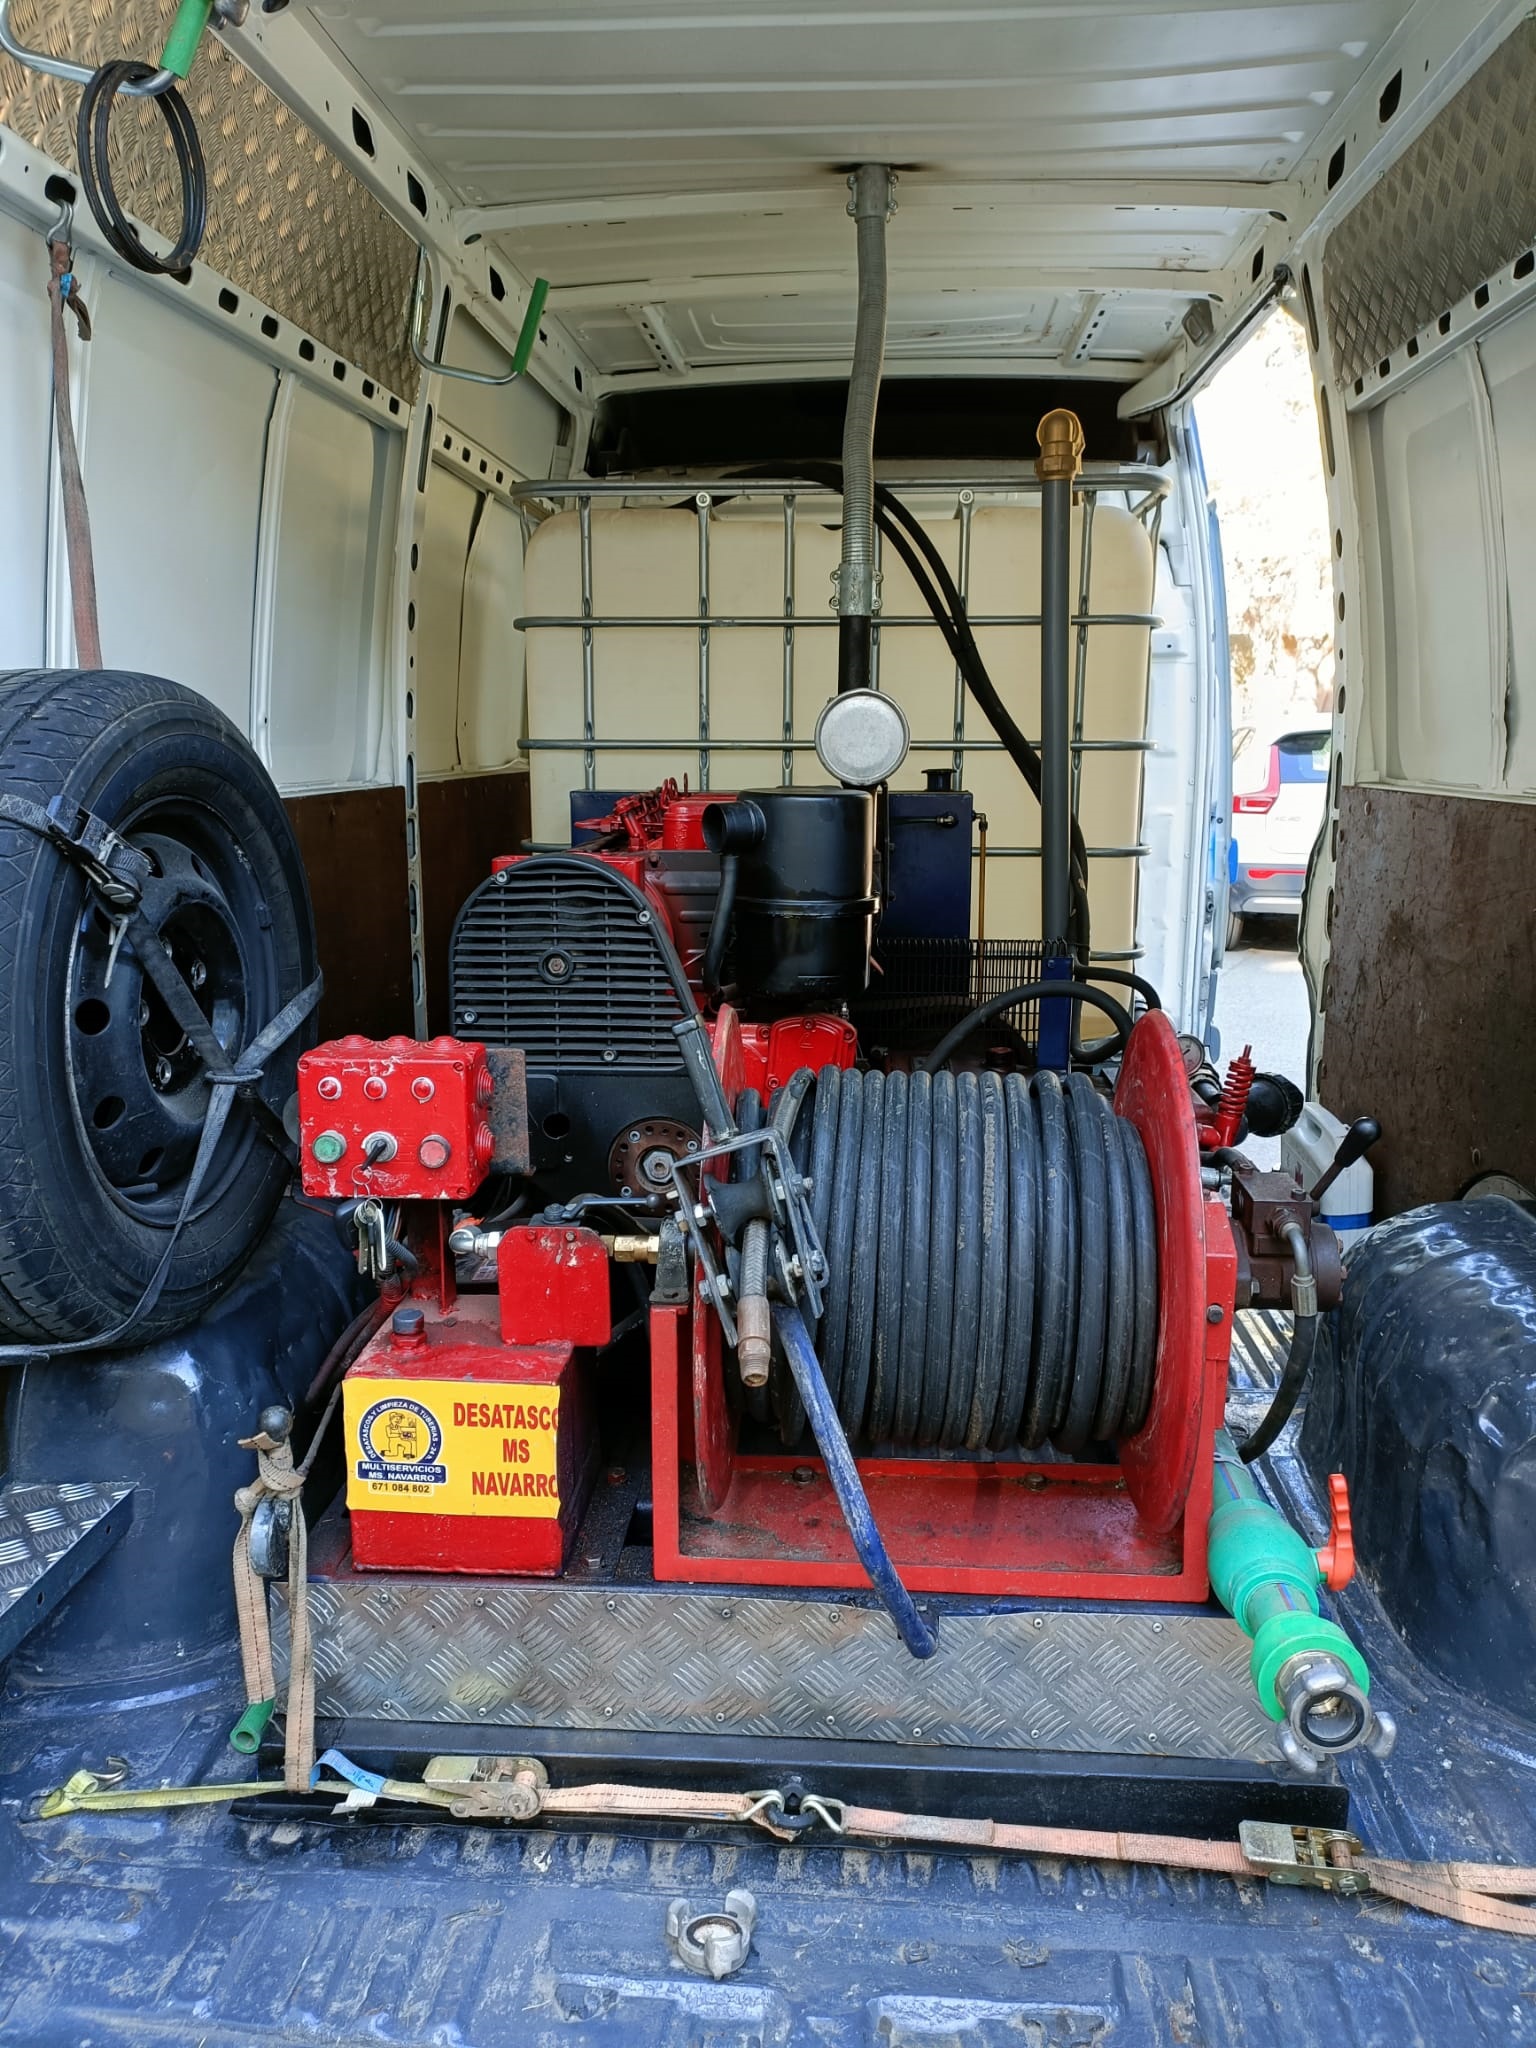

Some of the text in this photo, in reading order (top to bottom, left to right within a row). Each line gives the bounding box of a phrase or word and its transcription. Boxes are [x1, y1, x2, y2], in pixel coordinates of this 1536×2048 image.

[362, 1415, 377, 1459] DESATASCOS
[376, 1401, 408, 1414] LIMPIEZA
[408, 1403, 419, 1413] DE
[502, 1438, 530, 1464] MS
[361, 1462, 441, 1474] MULTISERVICIOS
[368, 1471, 435, 1482] MS. NAVARRO
[371, 1482, 430, 1493] 671 084 802
[472, 1471, 559, 1499] NAVARRO
